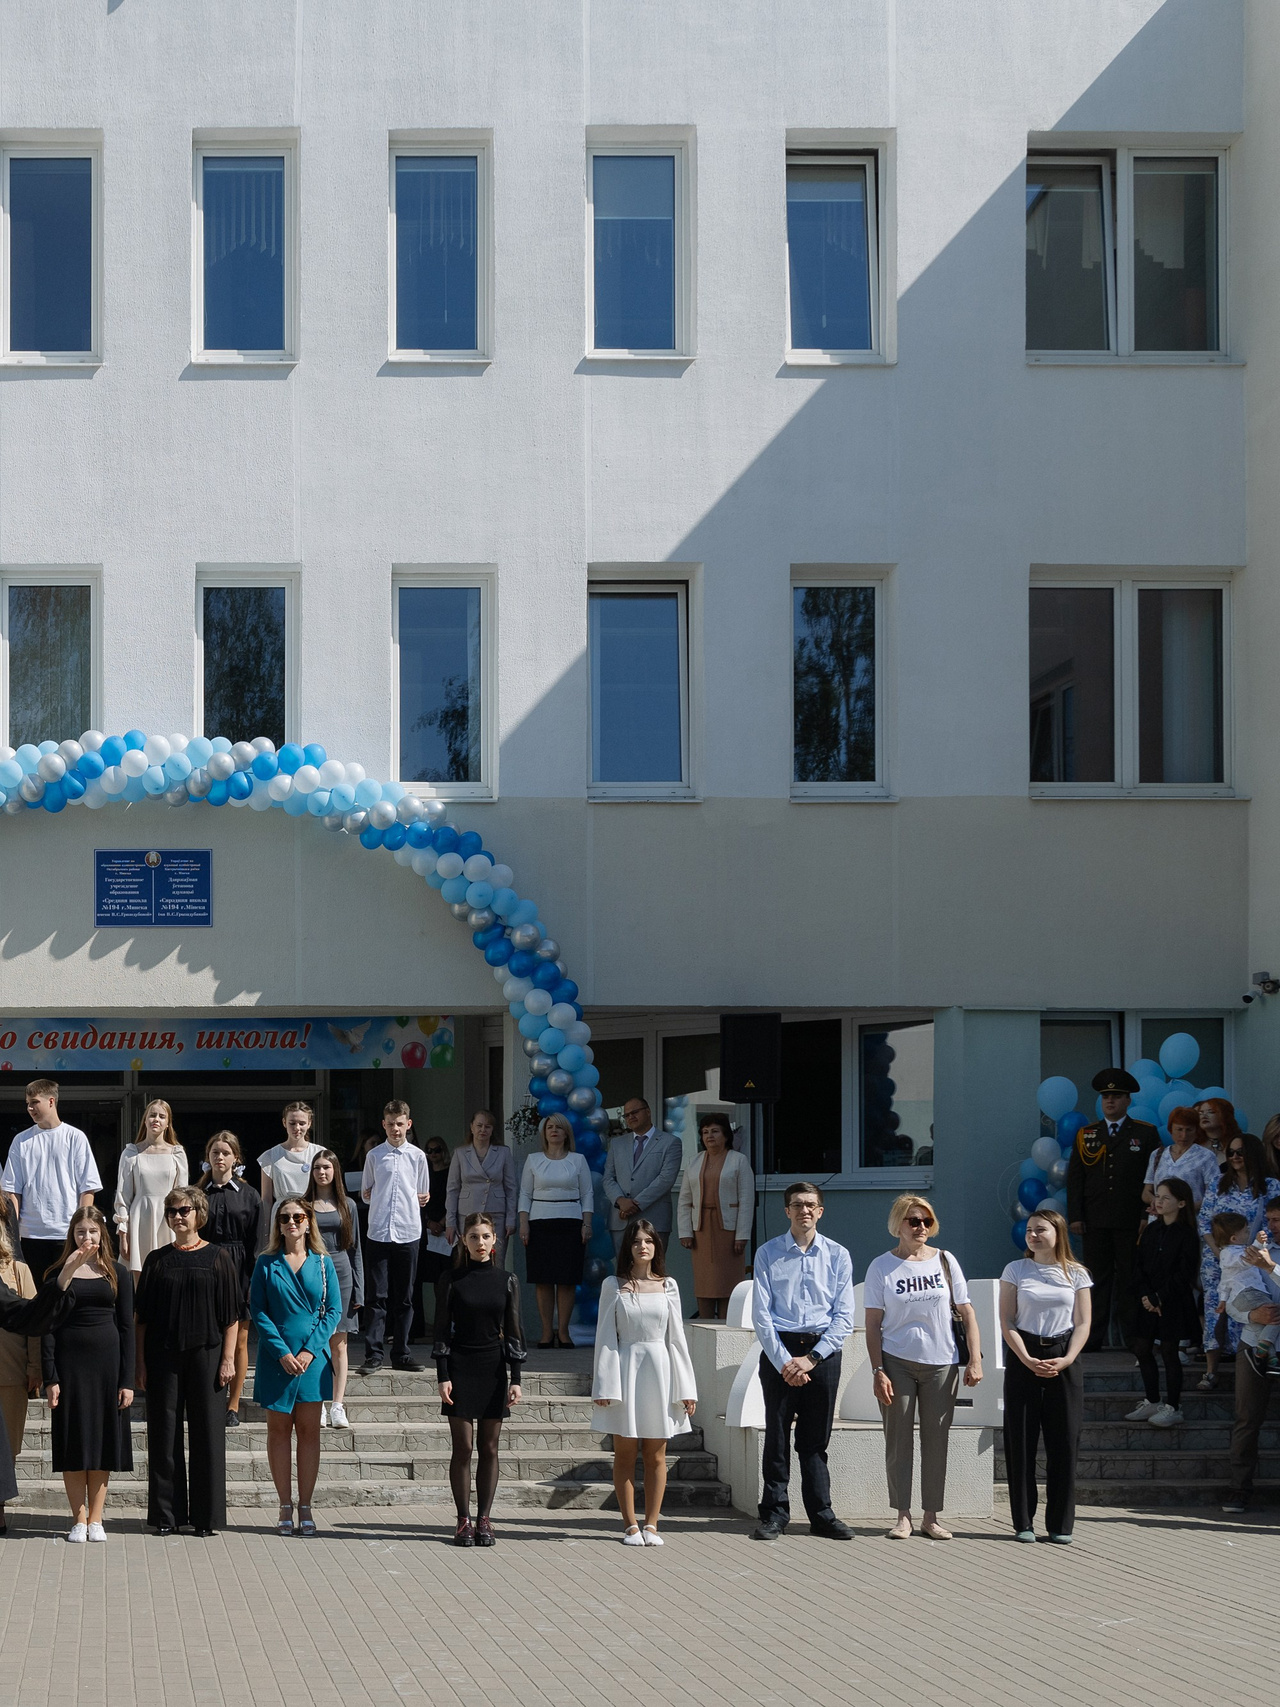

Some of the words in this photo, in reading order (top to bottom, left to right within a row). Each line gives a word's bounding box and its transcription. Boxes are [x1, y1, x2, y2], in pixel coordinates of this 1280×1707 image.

[26, 1024, 184, 1054] свидания,
[195, 1023, 312, 1049] школа!
[896, 1272, 944, 1294] SHINE
[904, 1292, 942, 1307] darling
